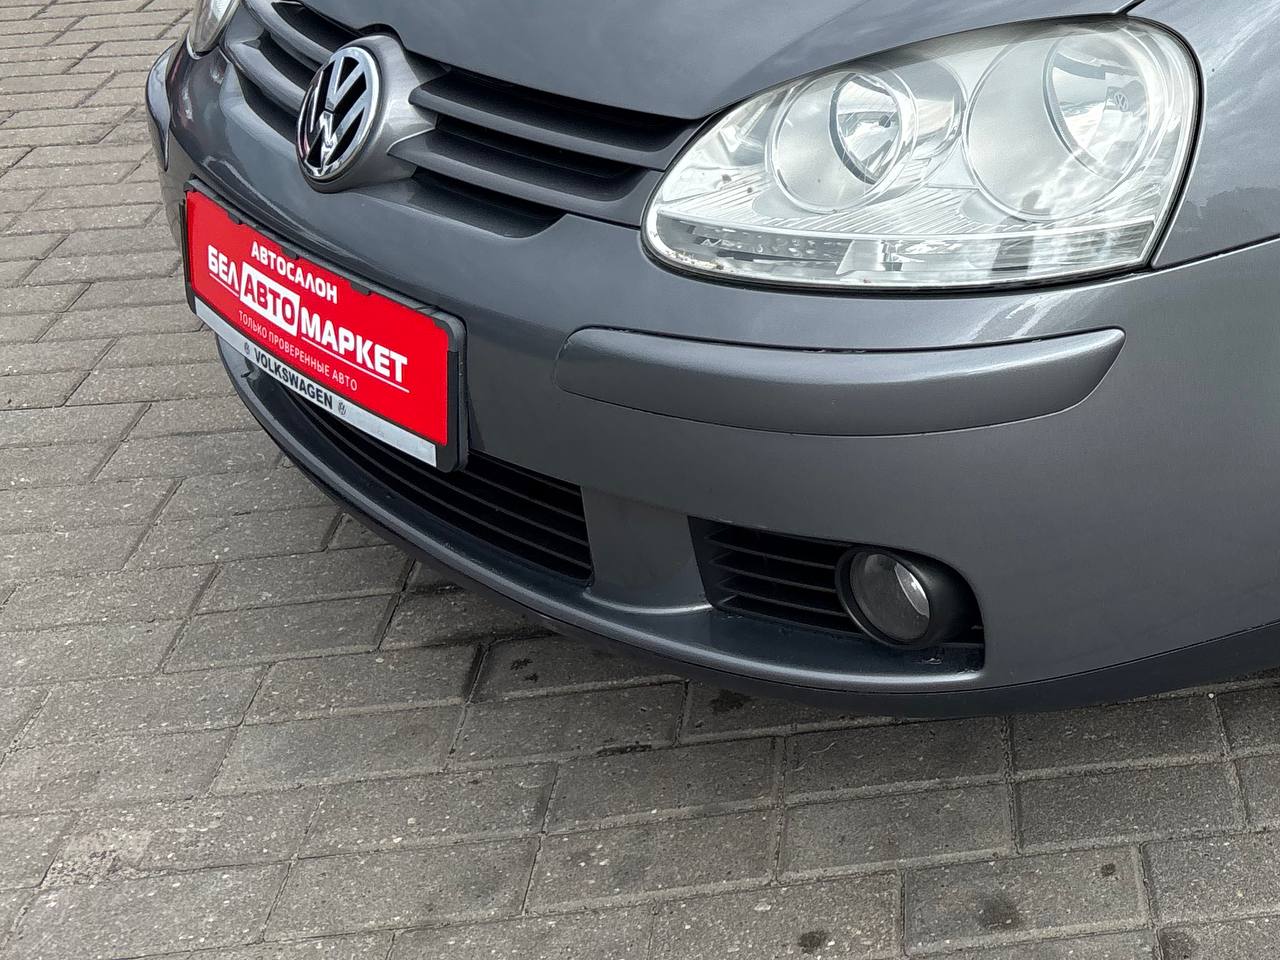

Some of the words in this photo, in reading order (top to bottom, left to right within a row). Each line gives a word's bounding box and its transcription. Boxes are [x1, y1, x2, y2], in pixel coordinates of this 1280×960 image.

[251, 241, 338, 305] АВТОСАЛОН
[238, 309, 268, 340] ТОЛЬКО
[268, 330, 330, 378] ПРОВЕРЕННЫЕ
[331, 369, 358, 392] АВТО
[253, 347, 333, 410] VOLKSWAGEN
